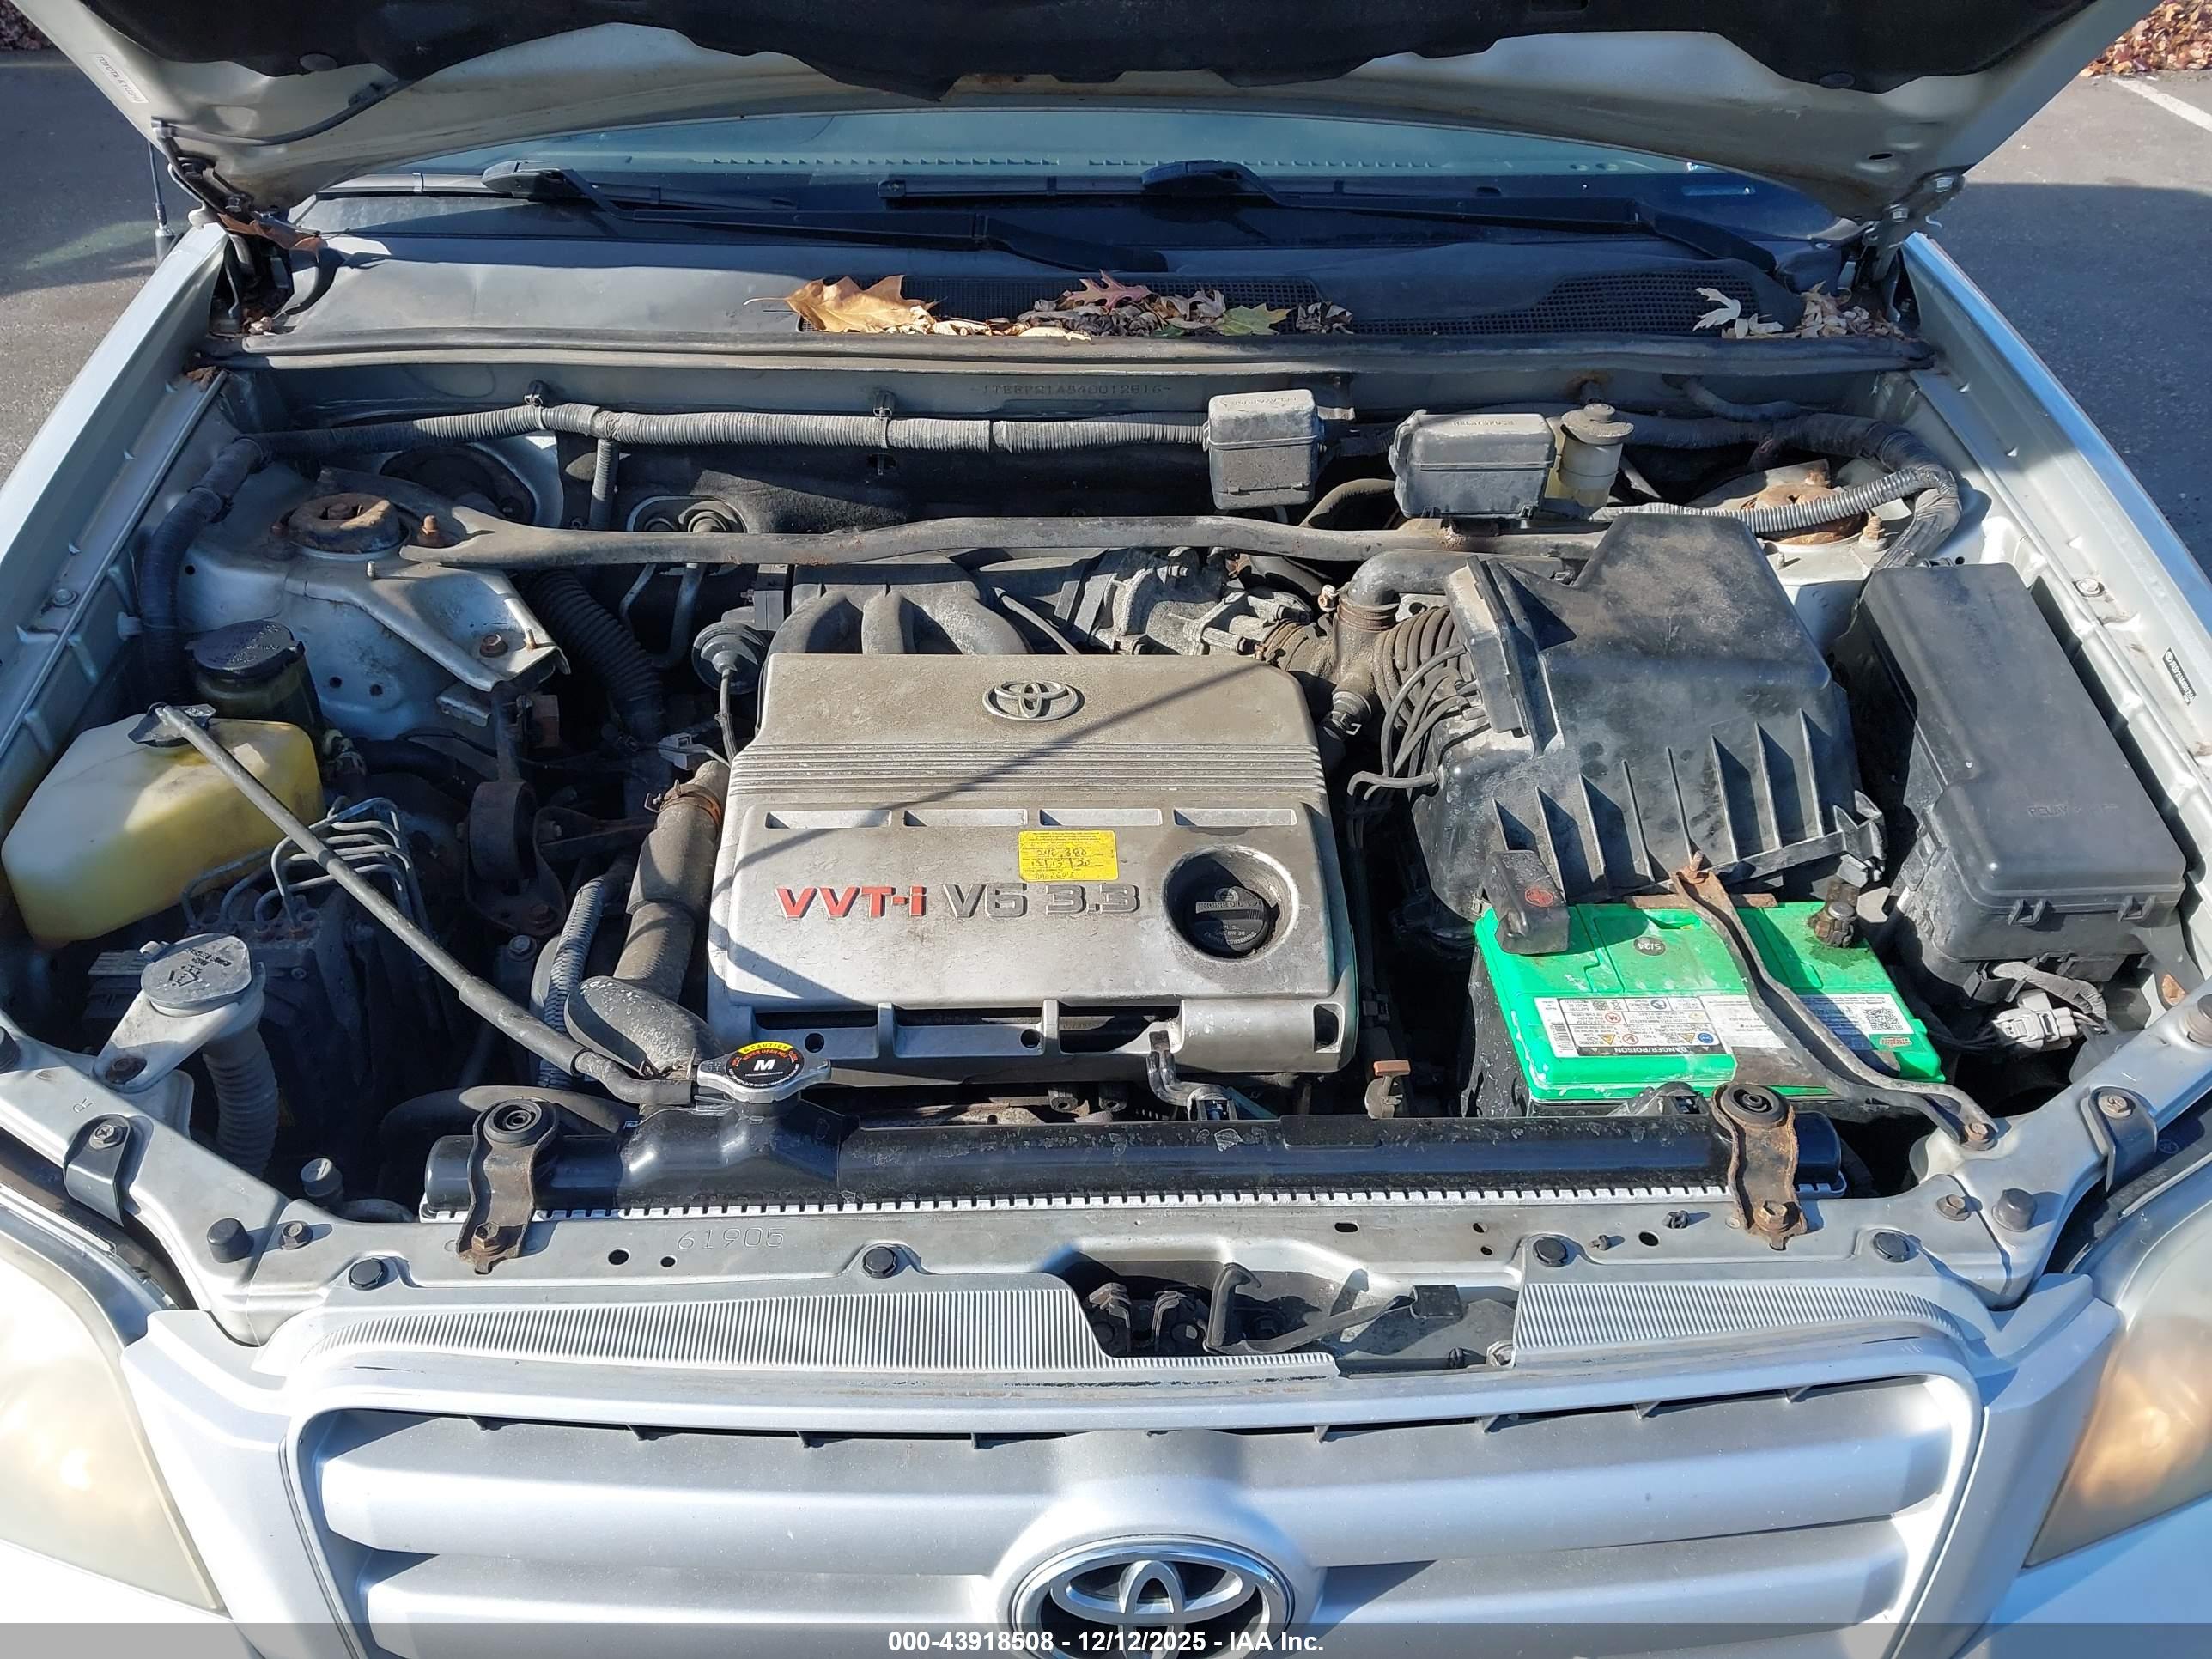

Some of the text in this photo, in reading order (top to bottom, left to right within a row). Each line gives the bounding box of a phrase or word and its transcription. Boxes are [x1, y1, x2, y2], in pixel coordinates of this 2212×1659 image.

[944, 883, 1028, 918] V6
[1046, 884, 1141, 915] 3.3
[677, 1227, 786, 1250] 61905
